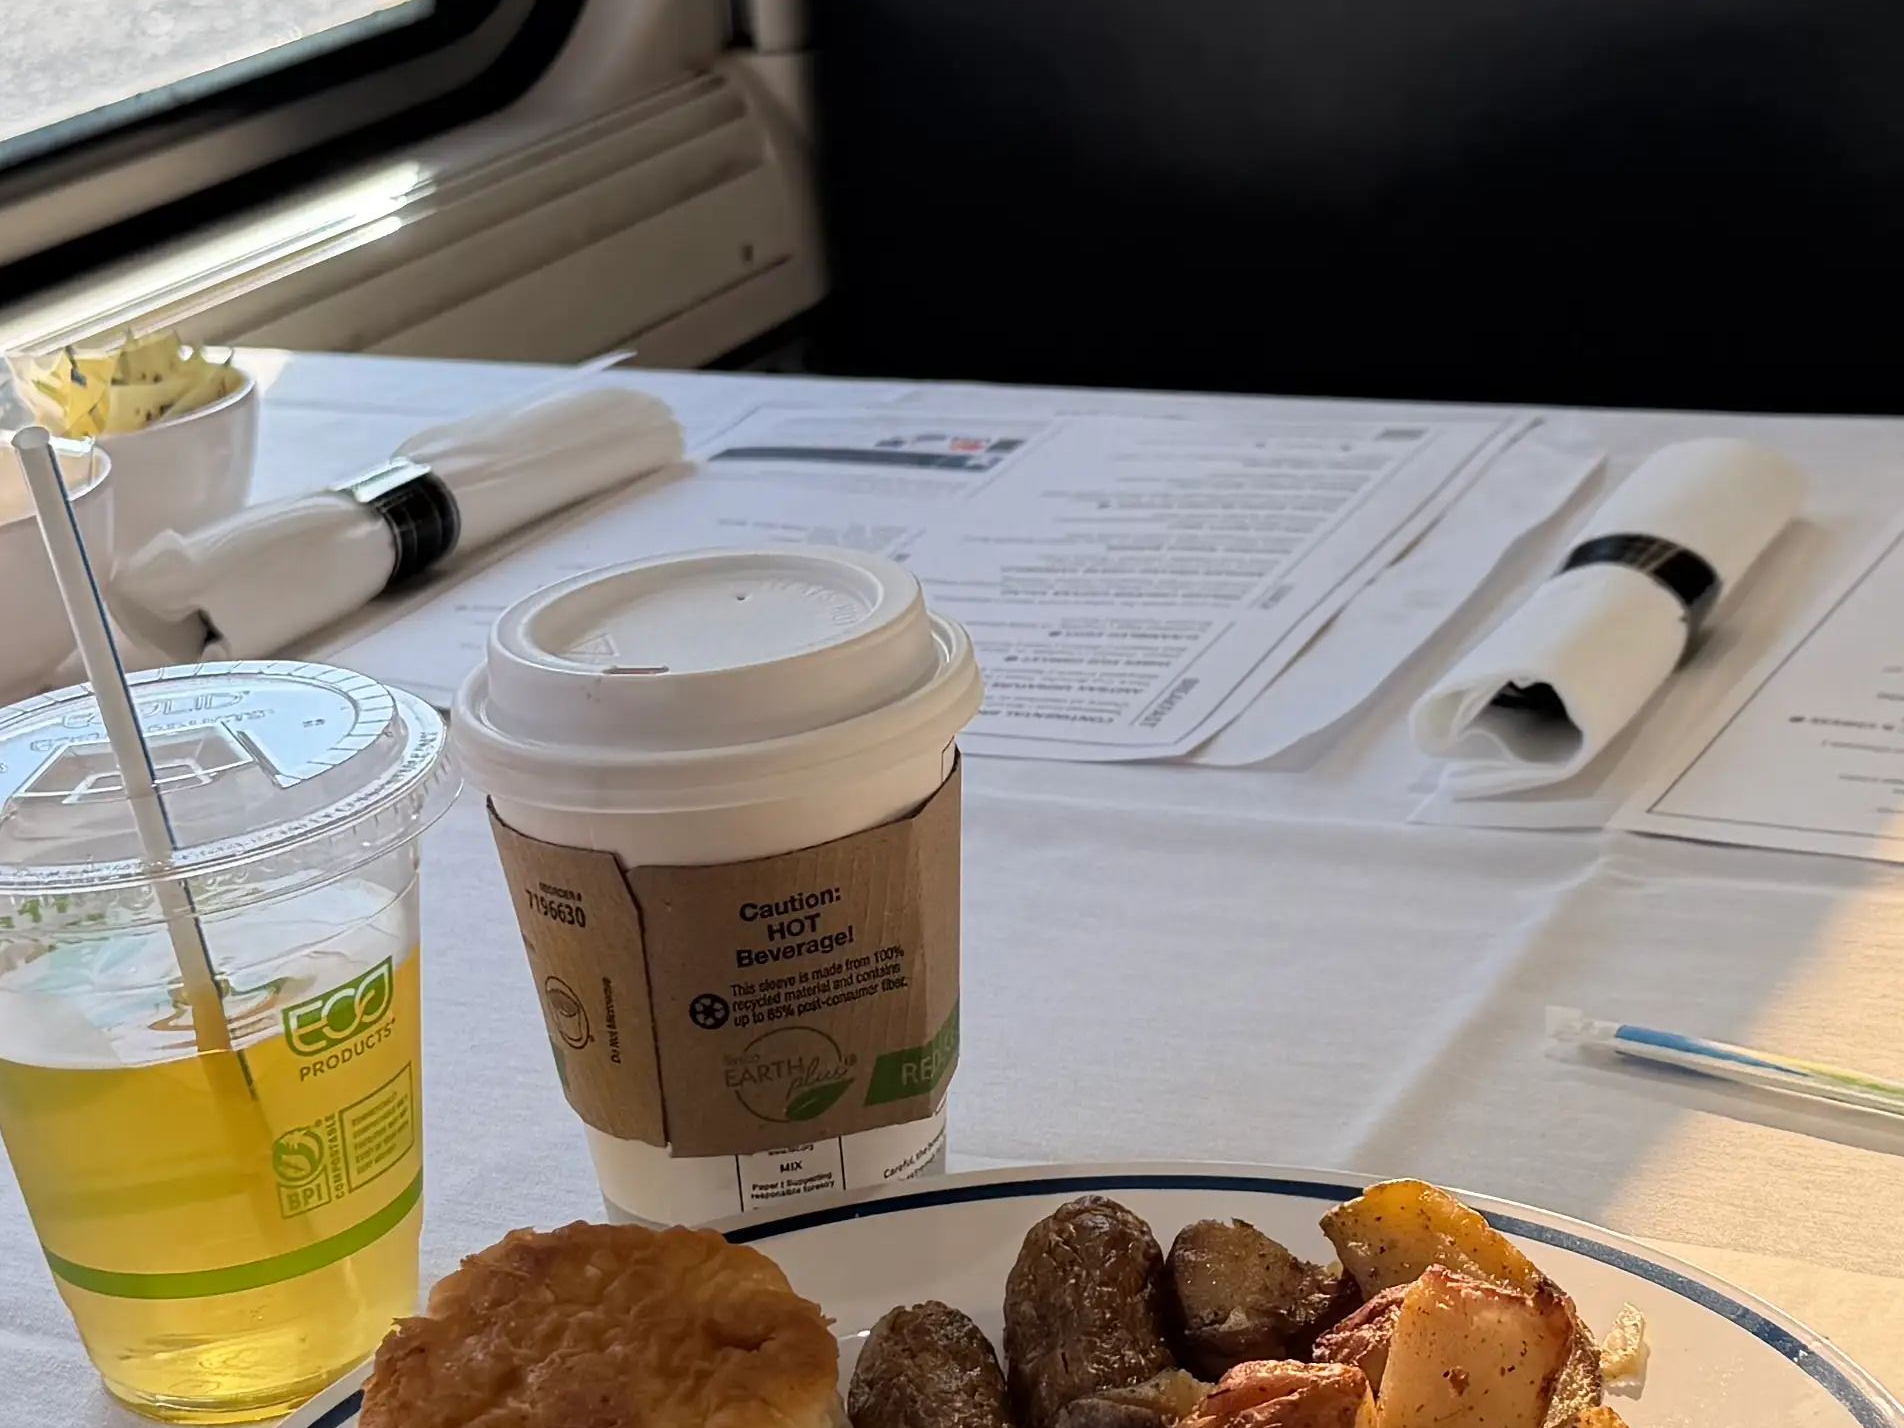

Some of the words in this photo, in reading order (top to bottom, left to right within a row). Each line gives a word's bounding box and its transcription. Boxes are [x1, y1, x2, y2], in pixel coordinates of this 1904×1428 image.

[525, 888, 587, 929] 7196630
[739, 887, 842, 922] Caution:
[736, 925, 855, 969] Beverage!
[767, 912, 821, 942] HOT
[730, 983, 756, 998] This
[758, 974, 796, 993] sleeve
[799, 971, 809, 984] is
[811, 962, 843, 982] made
[844, 954, 871, 972] from
[873, 943, 905, 964] 100%
[732, 991, 781, 1014] recycled
[783, 979, 831, 1003] material
[832, 974, 854, 991] and
[855, 962, 901, 985] contains
[288, 962, 392, 1053] ECO
[733, 1014, 748, 1028] up
[751, 1009, 765, 1025] to
[797, 983, 879, 1017] post-consumer
[299, 1026, 394, 1083] PRODUCTS
[724, 1056, 804, 1089] EARTH
[779, 1160, 803, 1174] MIX
[285, 1182, 324, 1213] BPI
